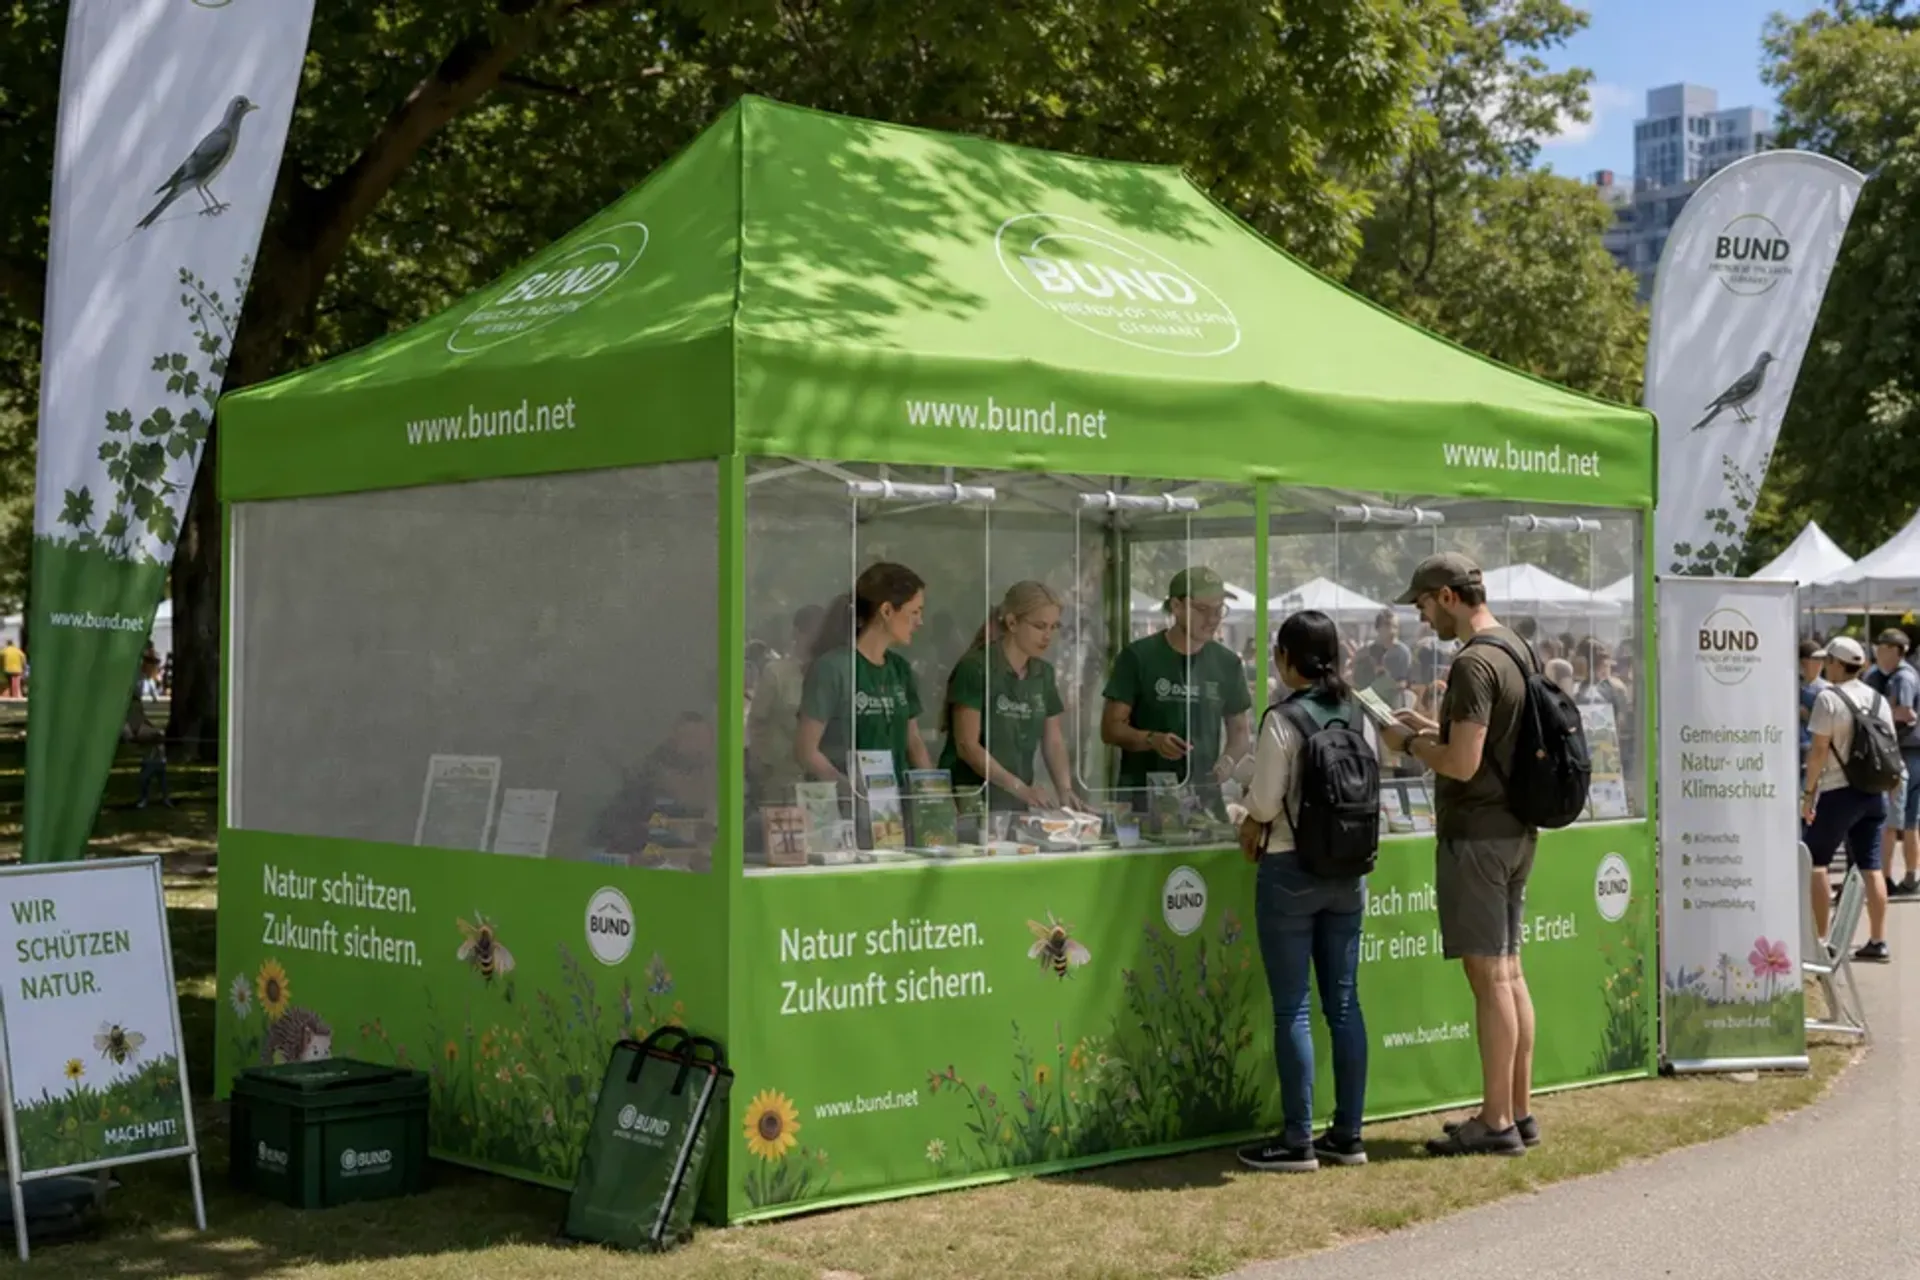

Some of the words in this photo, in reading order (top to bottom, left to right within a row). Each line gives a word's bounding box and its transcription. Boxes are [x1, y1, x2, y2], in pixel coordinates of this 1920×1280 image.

[1716, 236, 1790, 262] BUND
[496, 261, 620, 305] BUND
[1020, 255, 1197, 304] BUND
[407, 396, 576, 445] www.bund.net
[906, 396, 1107, 439] www.bund.net
[1443, 439, 1600, 477] www.bund.net
[50, 611, 144, 632] www.bund.net
[1699, 629, 1759, 651] BUND
[1680, 724, 1762, 744] Gemeinsam
[1764, 724, 1784, 744] für
[1681, 751, 1732, 771] Natur-
[1736, 752, 1763, 772] und
[1681, 779, 1776, 799] Klimaschutz
[263, 863, 317, 900] Natur
[322, 871, 416, 914] schützen.
[1167, 892, 1204, 910] BUND
[1408, 882, 1438, 912] mit
[1598, 878, 1629, 896] BUND
[11, 899, 56, 925] WIR
[590, 914, 631, 937] BUND
[16, 929, 131, 963] SCHÜTZEN
[262, 911, 339, 955] Zukunft
[344, 924, 422, 967] sichern.
[781, 927, 858, 962] Natur
[865, 918, 984, 955] schützen.
[1359, 930, 1385, 963] für
[1390, 929, 1428, 959] eine
[20, 970, 102, 1000] NATUR.
[780, 971, 887, 1015] Zukunft
[895, 966, 993, 1003] sichern.
[1382, 1021, 1470, 1049] www.bund.net
[813, 1088, 919, 1119] www.bund.net
[104, 1124, 146, 1145] MACH
[147, 1118, 177, 1138] MIT!
[634, 1113, 671, 1137] BUND
[357, 1149, 392, 1167] BUND
